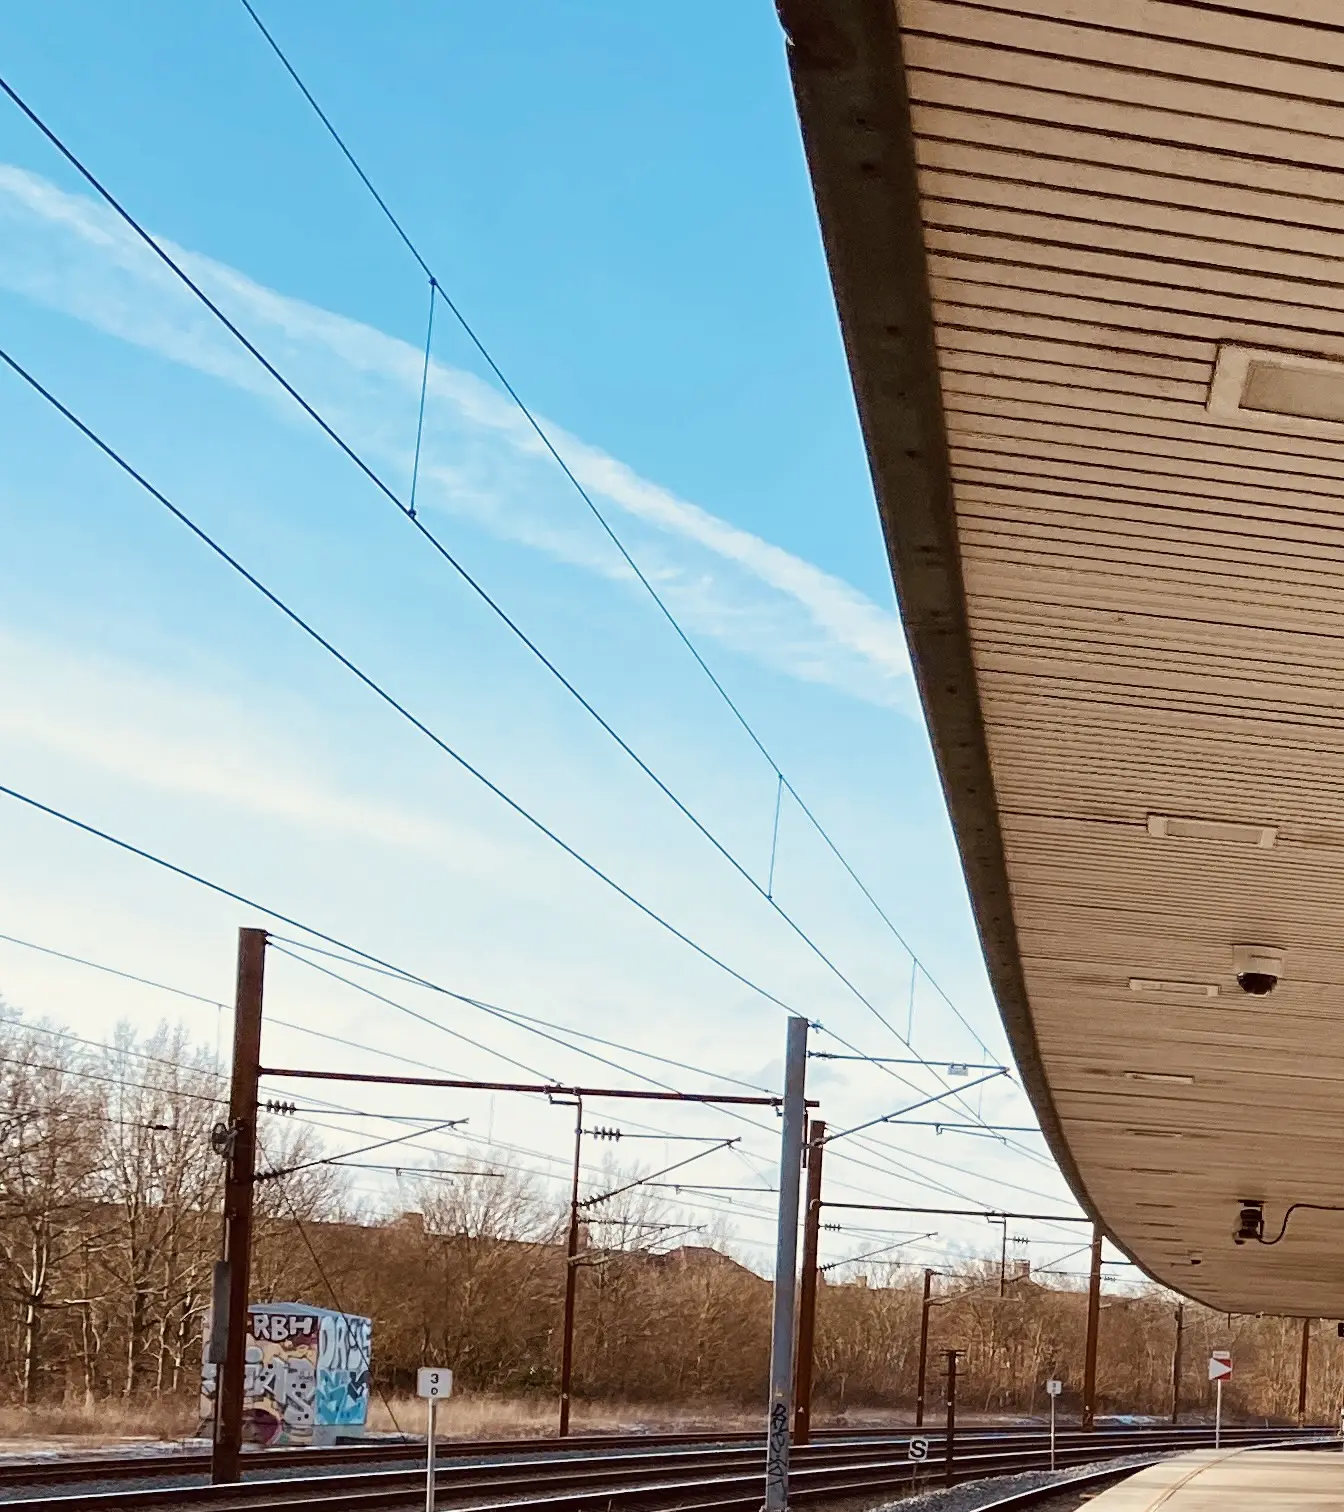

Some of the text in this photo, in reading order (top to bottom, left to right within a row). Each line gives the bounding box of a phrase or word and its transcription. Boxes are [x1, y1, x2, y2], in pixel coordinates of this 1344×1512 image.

[252, 1313, 313, 1342] RBH
[430, 1373, 440, 1384] 3
[911, 1439, 926, 1458] S
